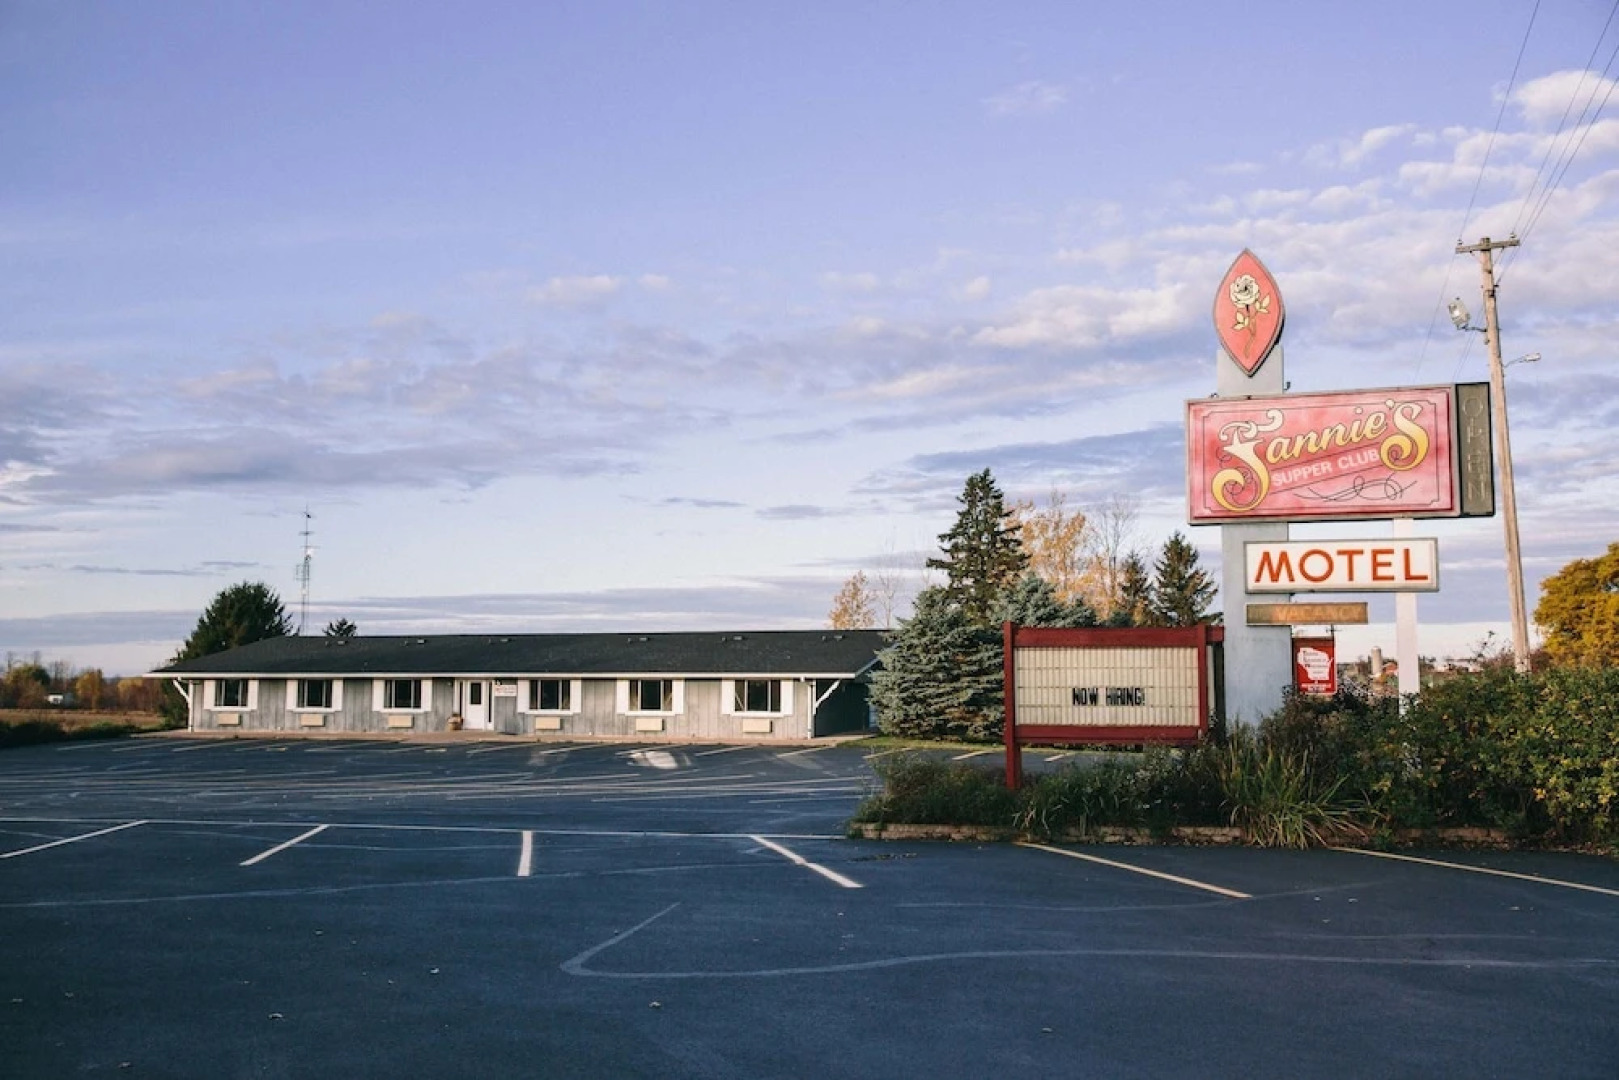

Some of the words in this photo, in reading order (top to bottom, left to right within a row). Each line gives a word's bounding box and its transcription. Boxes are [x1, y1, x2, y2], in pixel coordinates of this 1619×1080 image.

[1271, 461, 1332, 487] SUPPER
[1338, 450, 1380, 470] CLUB
[1254, 548, 1429, 583] MOTEL
[1072, 687, 1098, 706] NOW
